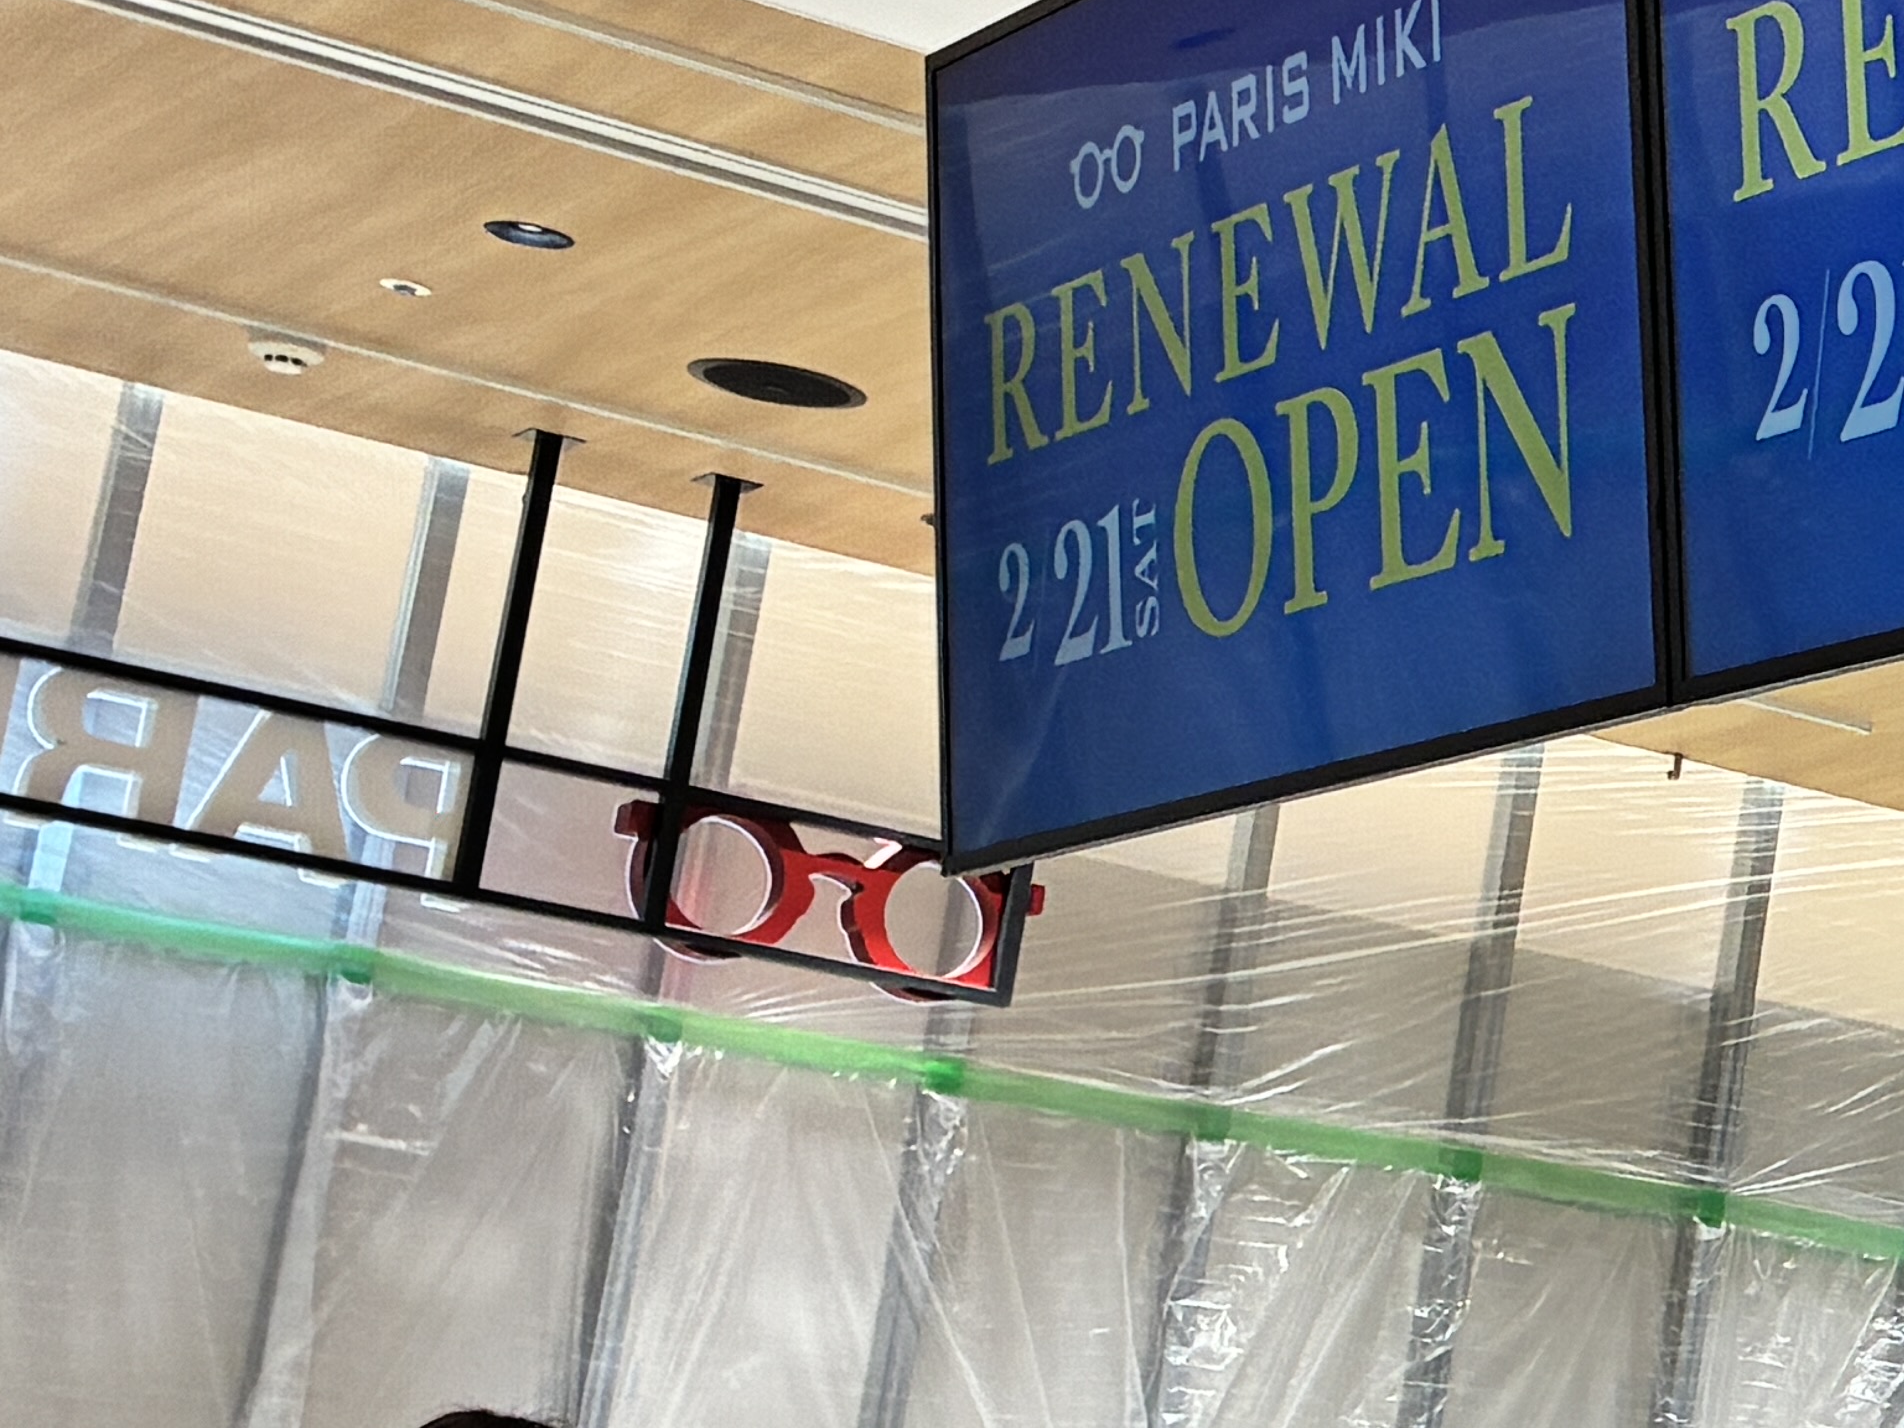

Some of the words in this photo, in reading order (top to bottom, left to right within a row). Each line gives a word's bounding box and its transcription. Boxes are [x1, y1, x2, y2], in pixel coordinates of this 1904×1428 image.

[1172, 50, 1311, 171] PARIS
[984, 96, 1573, 466] RENEWAL
[1133, 498, 1160, 638] SAT
[1173, 303, 1576, 637] OPEN
